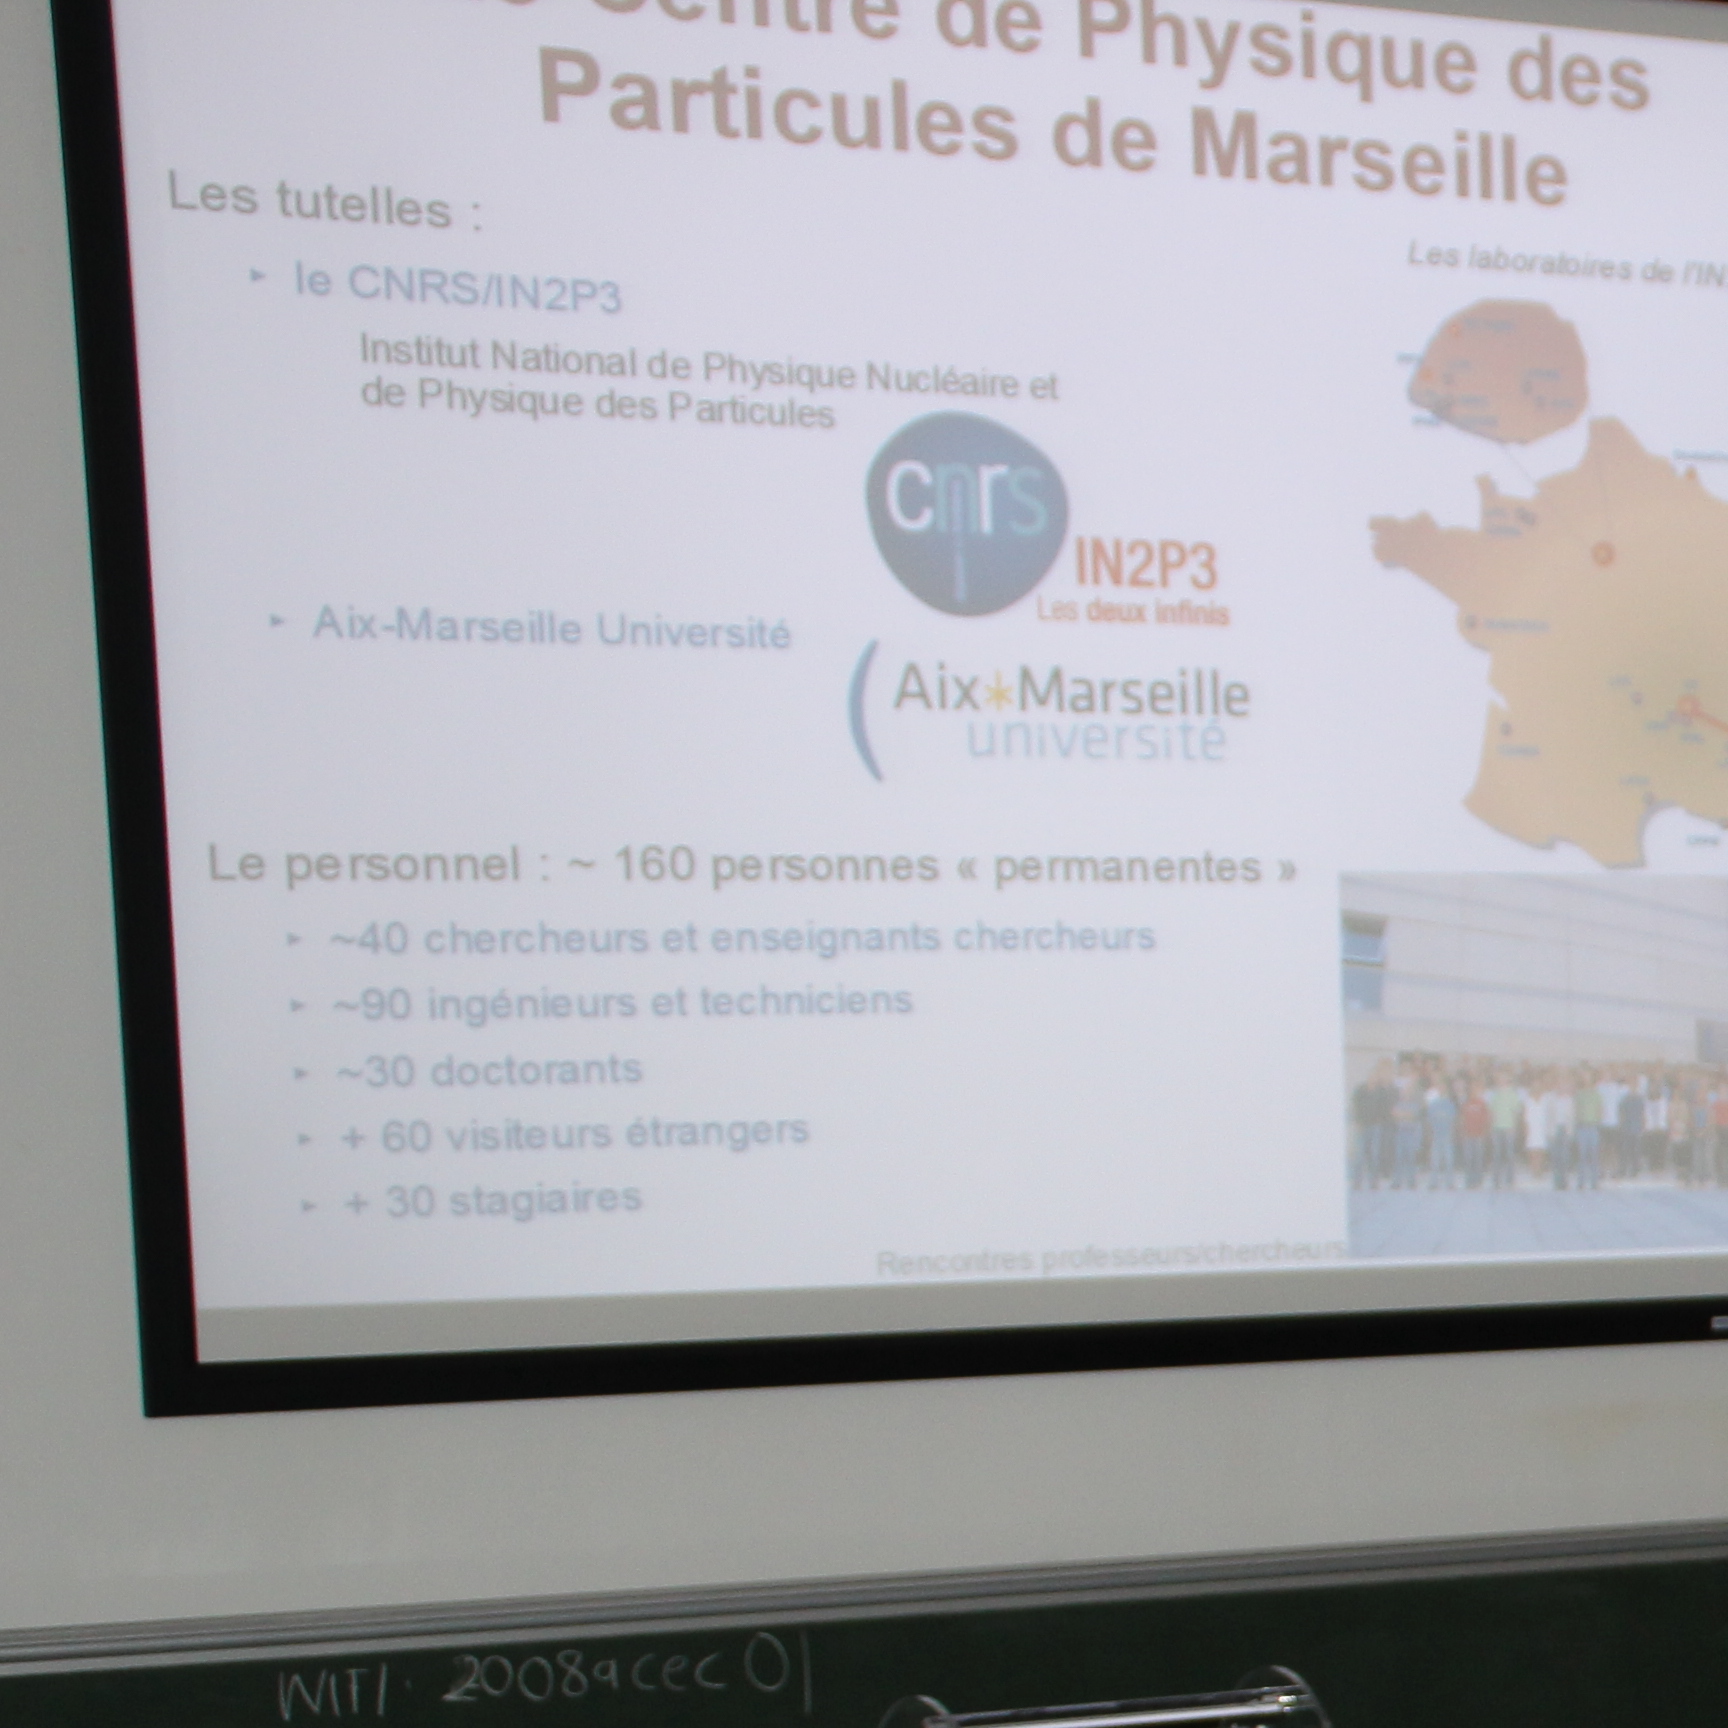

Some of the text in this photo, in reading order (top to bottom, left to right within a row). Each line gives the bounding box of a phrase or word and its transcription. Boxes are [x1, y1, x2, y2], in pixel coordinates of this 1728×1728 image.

[934, 0, 1044, 55] de
[1076, 0, 1478, 103] Physique
[1507, 34, 1652, 111] des
[539, 46, 1571, 207] Particules de Marseille
[167, 169, 259, 215] Les
[277, 180, 452, 230] tutelles
[1408, 240, 1459, 268] Les
[1468, 243, 1632, 280] laboratoires
[1641, 256, 1675, 283] de
[294, 260, 624, 315] le CNRS/IN2P3
[360, 332, 1060, 403] Institut National de Physique Nucléaire et
[360, 375, 837, 430] de Physique des Particules
[1075, 537, 1219, 591] IN2P3
[313, 605, 794, 652] Aix-Marseille Université
[1037, 595, 1231, 629] Les deux infinis
[967, 718, 1228, 763] université
[209, 843, 265, 884] Le
[285, 843, 521, 892] personnel
[615, 844, 697, 884] 160
[712, 849, 940, 893] personnes
[995, 849, 1263, 890] permanentes
[330, 917, 1157, 962] ~40 chercheurs et enseignants chercheurs
[332, 983, 914, 1031] ~90 ingénieurs et techniciens
[335, 1052, 644, 1091] ~30 doctorants
[381, 1119, 433, 1154] 60
[446, 1116, 612, 1154] visiteurs
[626, 1110, 811, 1156] étrangers
[385, 1184, 437, 1219] 30
[450, 1180, 643, 1223] stagiaires
[876, 1249, 1037, 1277] Rencontres
